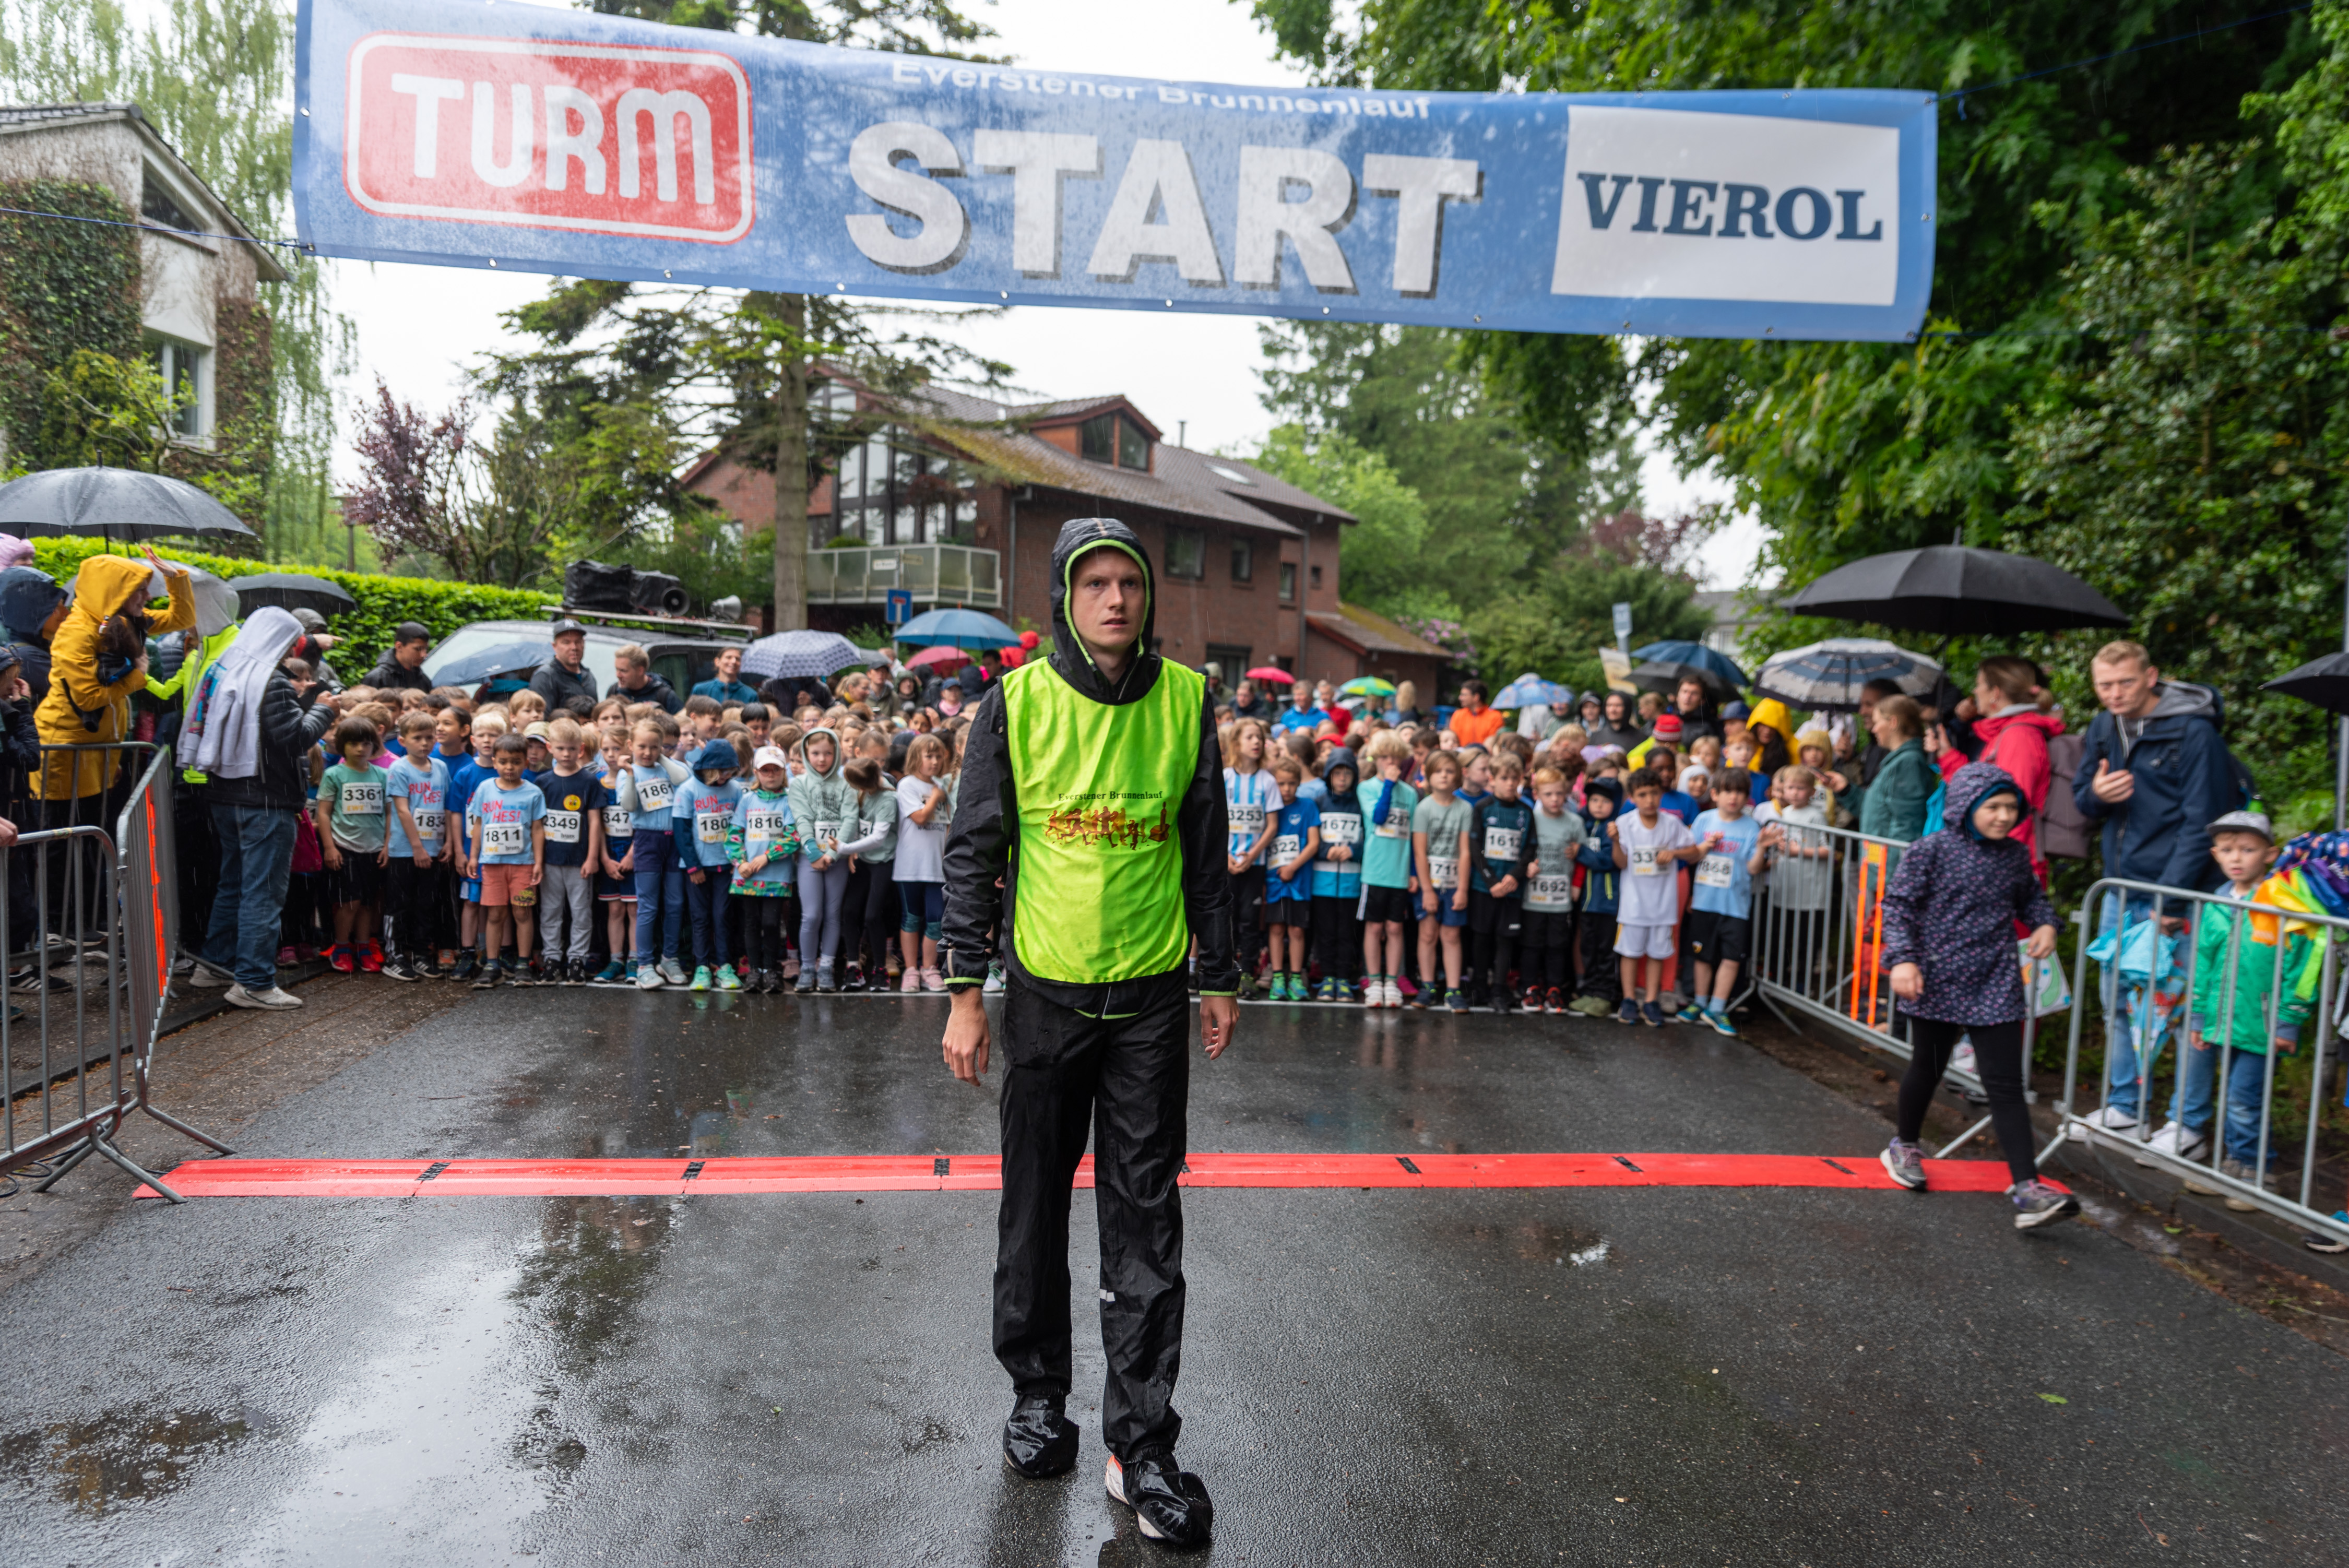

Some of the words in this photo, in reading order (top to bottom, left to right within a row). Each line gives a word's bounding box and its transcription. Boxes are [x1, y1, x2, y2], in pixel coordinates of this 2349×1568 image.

[892, 59, 1143, 100] Everstener
[1158, 86, 1431, 120] Brunnenlauf
[391, 73, 715, 205] TURM
[845, 121, 1485, 299] START
[1576, 171, 1883, 242] VIEROL
[345, 789, 382, 801] 3361
[640, 783, 674, 798] 1861
[1058, 792, 1106, 801] Everstener
[1109, 790, 1163, 800] Brunnenlauf
[482, 799, 503, 814] RUN
[695, 794, 718, 812] RUN
[492, 810, 521, 823] HES!
[1229, 809, 1262, 822] 3253
[749, 816, 783, 829] 1816
[1323, 819, 1357, 831] 1677
[485, 829, 520, 842] 1811
[1529, 880, 1565, 893] 1692
